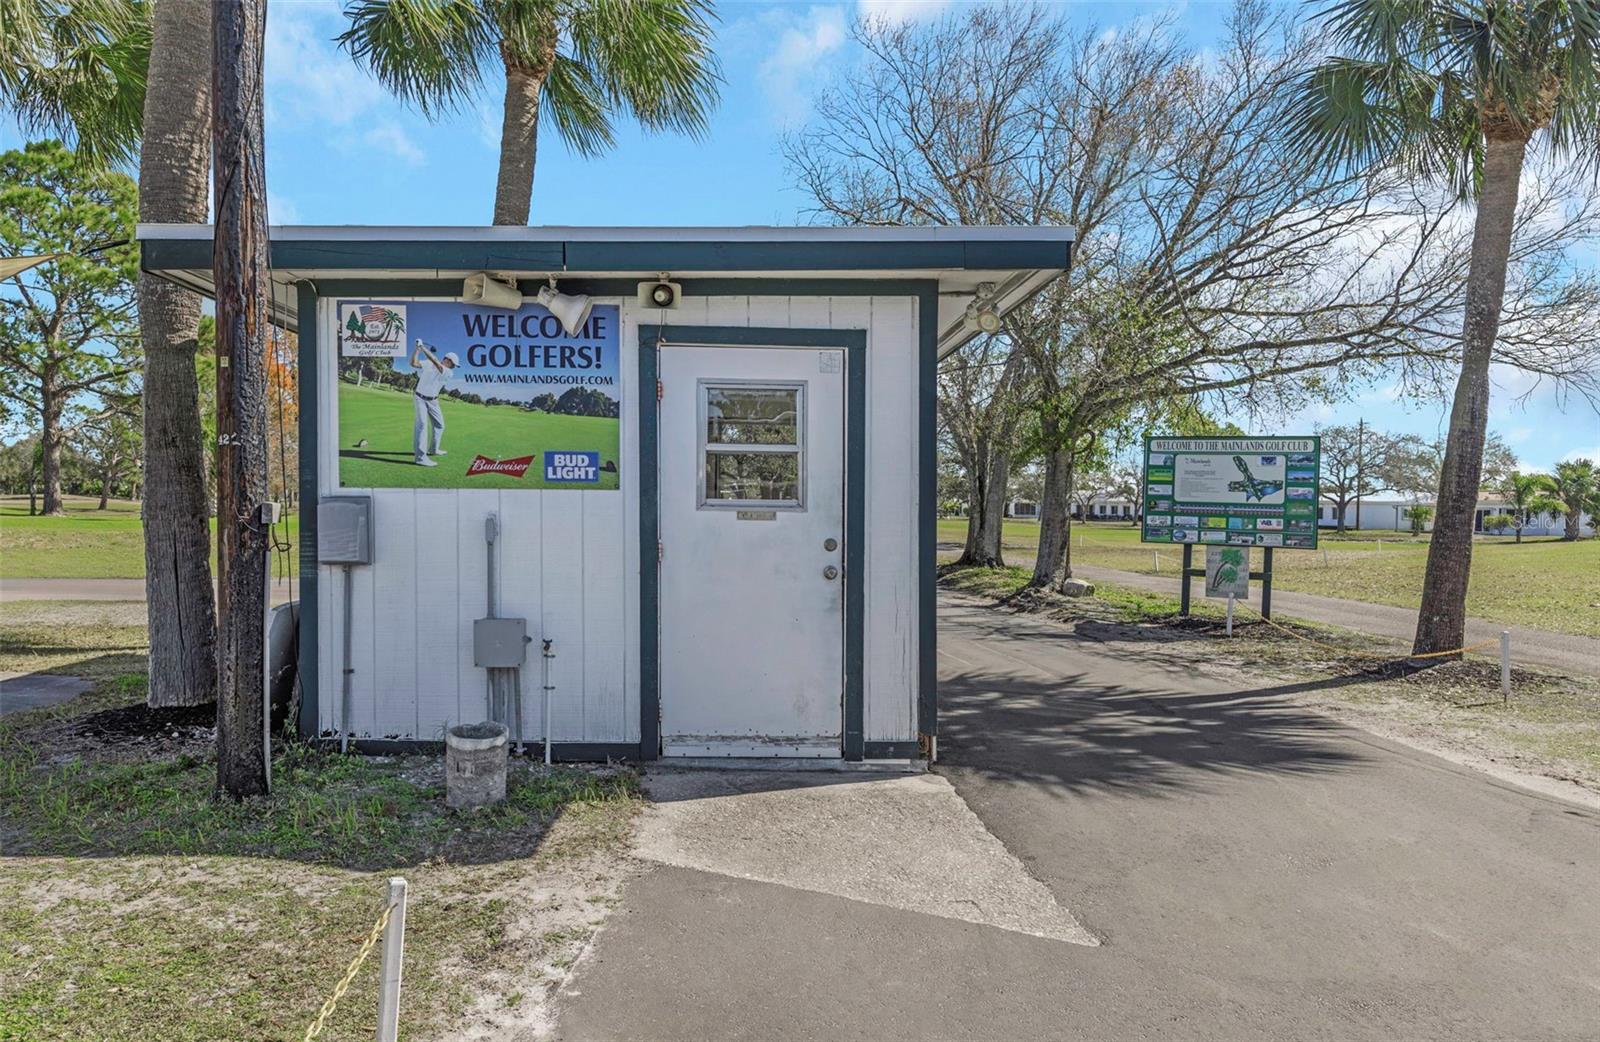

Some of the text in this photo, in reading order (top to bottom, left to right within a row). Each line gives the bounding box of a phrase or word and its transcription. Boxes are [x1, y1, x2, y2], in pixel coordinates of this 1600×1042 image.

[467, 344, 602, 369] GOLFERS!
[464, 374, 614, 385] WWW.MAINLANDSGOLF.COM
[1156, 441, 1309, 451] WELCOME TO THE MAINLANDS GOLF CLUB
[472, 459, 529, 472] Budweiser
[554, 454, 589, 467] BUD
[547, 467, 596, 479] LIGHT
